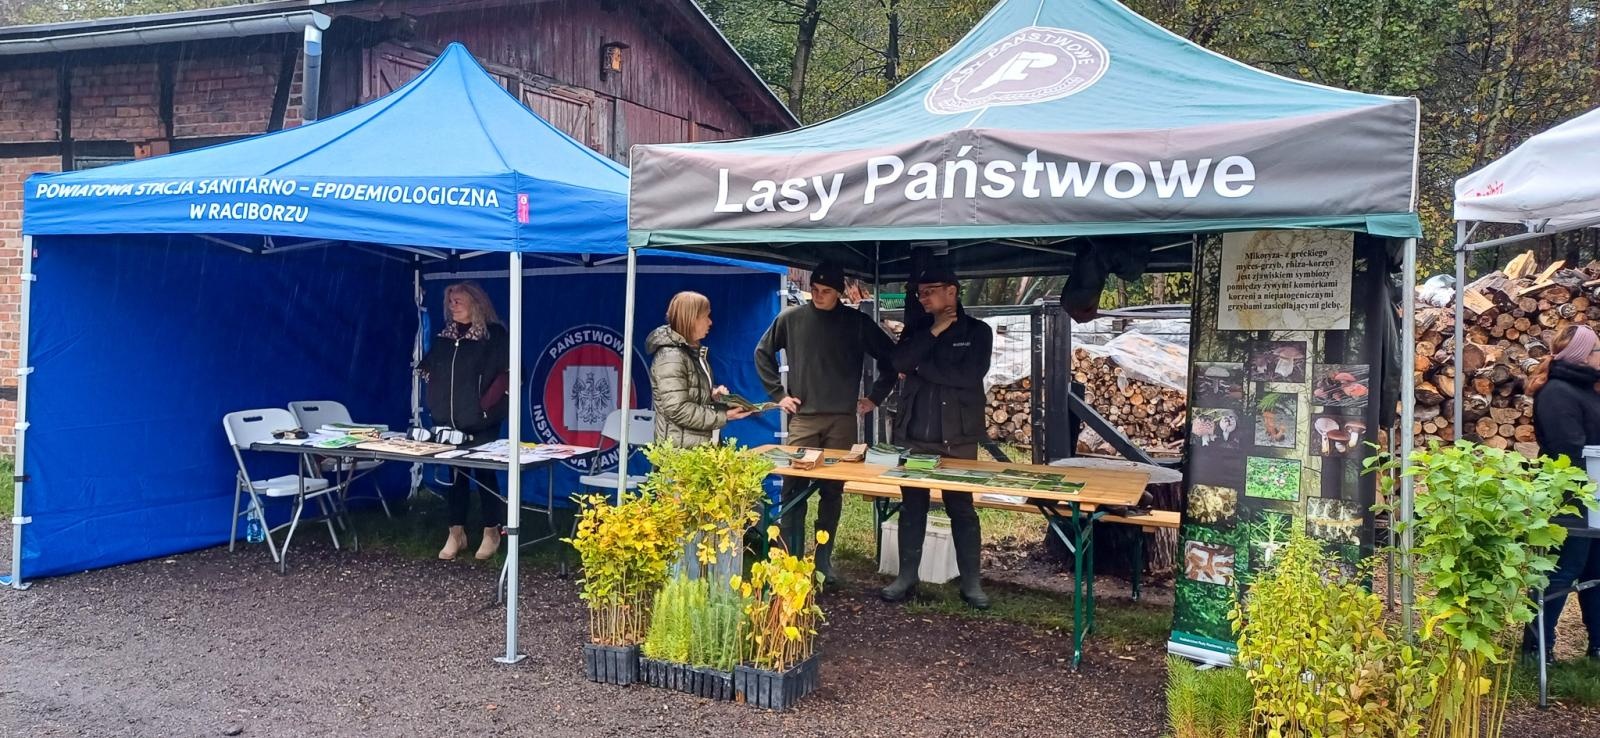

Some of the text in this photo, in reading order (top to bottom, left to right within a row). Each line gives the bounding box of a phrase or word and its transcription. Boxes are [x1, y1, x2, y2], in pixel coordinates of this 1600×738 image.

[713, 145, 1256, 221] Lasy Państwowe
[35, 183, 134, 198] POWIATOWA
[135, 181, 194, 196] STACJA
[197, 177, 297, 196] SANITARNO
[311, 182, 500, 207] EPIDEMIOLOGICZNA
[189, 203, 309, 222] W RACIBORZU
[1291, 249, 1328, 259] greckiego
[1295, 269, 1330, 280] symbiozy
[1226, 282, 1261, 292] pomiędzy
[1293, 279, 1338, 289] komórkami
[1228, 292, 1256, 300] korzeni
[1263, 290, 1334, 301] niepatogenicznymi
[1227, 302, 1263, 311] grzybami
[549, 330, 624, 359] PAŃSTWOW
